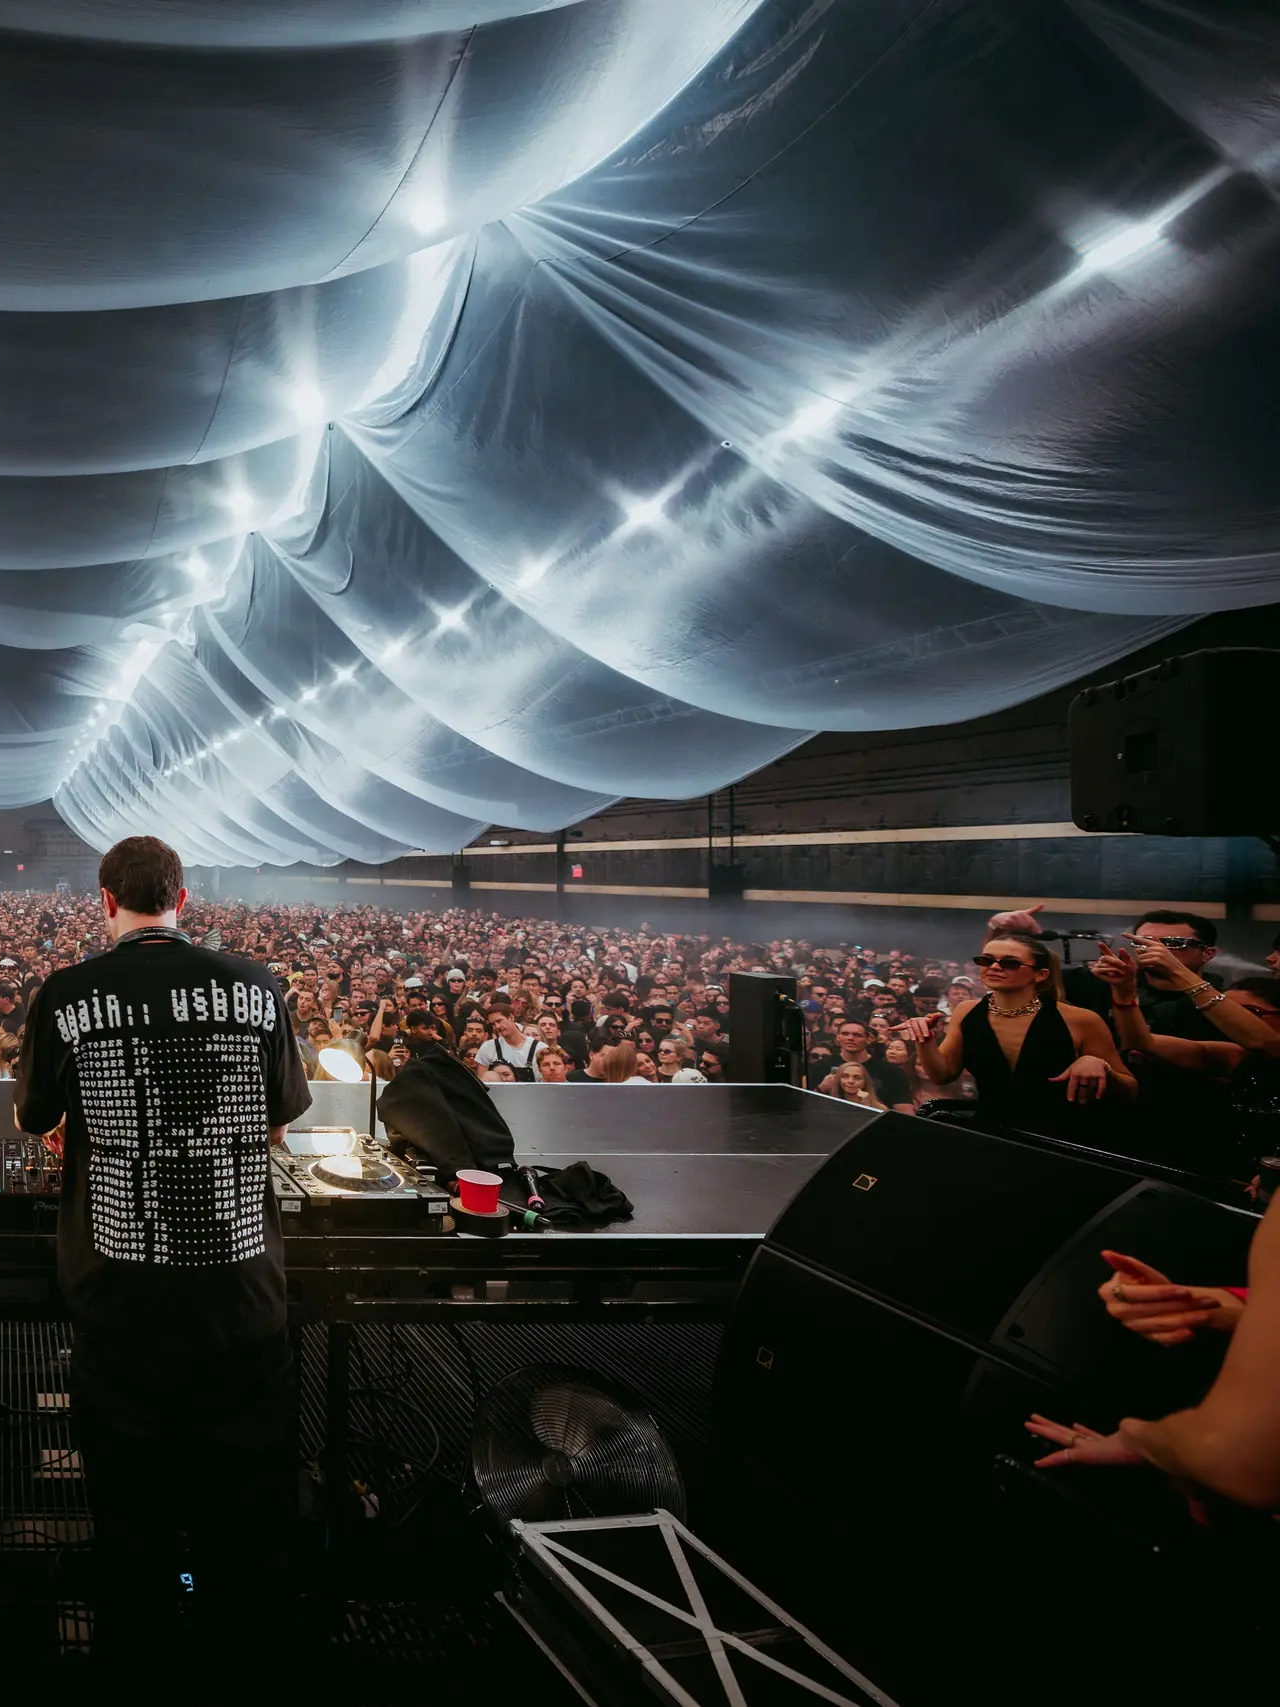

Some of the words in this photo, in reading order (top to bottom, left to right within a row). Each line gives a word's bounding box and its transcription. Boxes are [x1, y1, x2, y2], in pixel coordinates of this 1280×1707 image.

[73, 1040, 123, 1054] OCTOBER
[212, 1034, 260, 1044] GLASGW
[76, 1049, 124, 1061] OCTOBER
[77, 1060, 125, 1068] OCTOBER
[221, 1055, 259, 1063] MADRI
[79, 1069, 126, 1078] OCTOBER
[80, 1079, 135, 1088] NOVEMBER
[222, 1075, 263, 1083] DUBLI
[81, 1089, 136, 1097] NOVEMBER
[216, 1084, 265, 1093] TORONTO
[82, 1099, 137, 1107] NOVEMBER
[217, 1094, 266, 1103] TORONTO
[83, 1108, 137, 1117] NOVEMBER
[217, 1104, 266, 1114] CHICAGO
[86, 1117, 138, 1127] NOVEMBER
[202, 1114, 267, 1124] VANCOUVER
[88, 1126, 138, 1138] DECEMBER
[171, 1128, 194, 1136] SAN
[203, 1124, 267, 1135] FRANCISCO
[90, 1135, 139, 1148] DECEMBER
[187, 1137, 233, 1147] MEXICO
[241, 1134, 267, 1143] CITY
[149, 1149, 179, 1157] MORE
[188, 1148, 227, 1157] SHOWS
[90, 1154, 132, 1168] JANUARY
[213, 1157, 233, 1167] NEW
[241, 1154, 268, 1163] YORK
[89, 1165, 133, 1178] JANUARY
[214, 1168, 234, 1177] NEW
[240, 1164, 267, 1173] YORK
[89, 1174, 133, 1189] JANUARY
[214, 1179, 234, 1188] NEW
[240, 1174, 267, 1184] YORK
[90, 1184, 134, 1199] JANUARY
[215, 1189, 235, 1198] NEW
[240, 1184, 266, 1194] YORK
[91, 1193, 135, 1209] JANUARY
[215, 1200, 236, 1209] NEW
[240, 1193, 264, 1205] YORK
[92, 1203, 136, 1219] JANUARY
[215, 1211, 236, 1220] NEW
[240, 1203, 263, 1215] YORK
[92, 1213, 144, 1229] FEBRUARY
[230, 1214, 263, 1230] LONDON
[93, 1223, 145, 1239] FEBRUARY
[231, 1224, 263, 1240] LONDON
[94, 1232, 145, 1250] FEBRUARY
[231, 1234, 264, 1251] LONDON
[95, 1242, 146, 1262] FEBRUARY
[231, 1245, 266, 1262] LONDON
